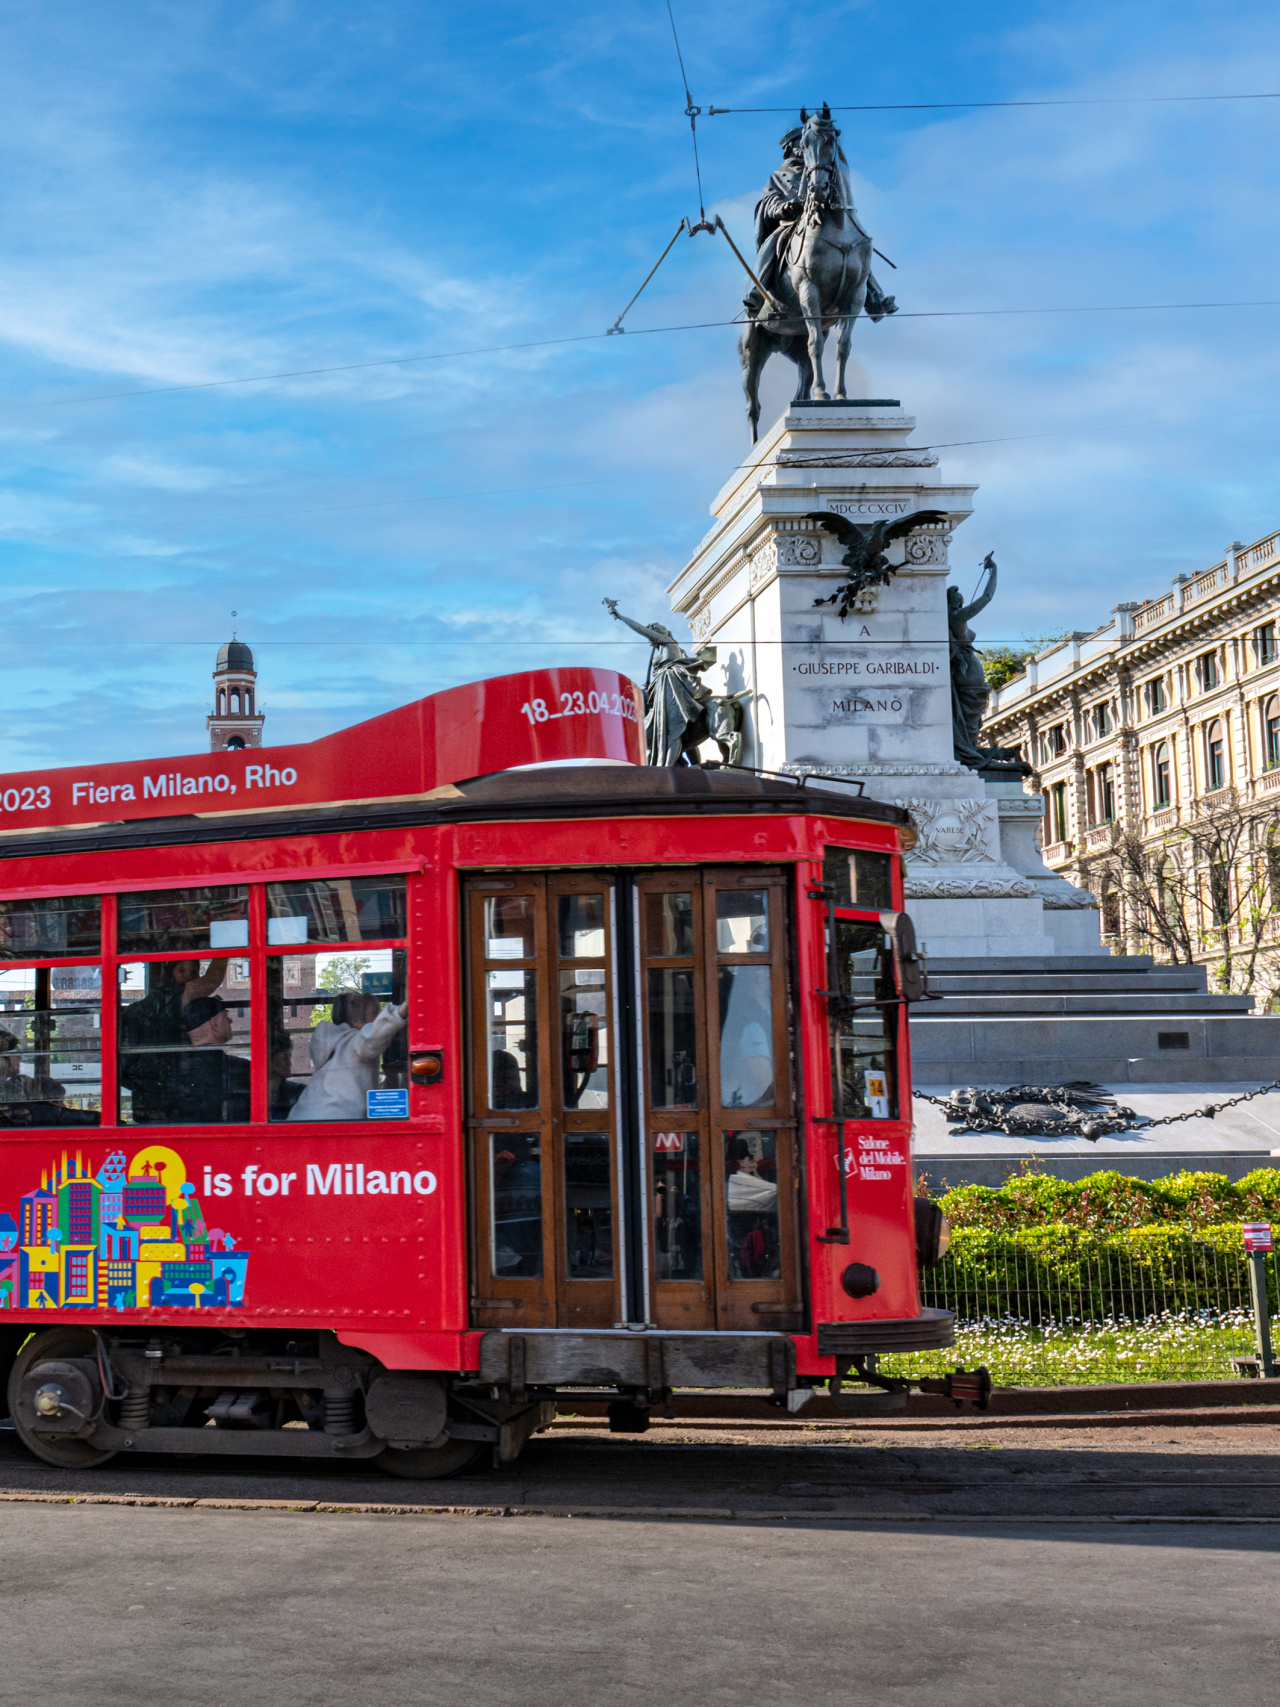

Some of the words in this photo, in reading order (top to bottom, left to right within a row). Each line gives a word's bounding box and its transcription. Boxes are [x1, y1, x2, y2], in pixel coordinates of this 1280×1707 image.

[829, 504, 907, 514] MDCCCXCIV
[859, 625, 871, 636] A
[832, 700, 903, 712] MILANO
[72, 782, 135, 806] Fiera
[143, 773, 238, 800] Milano,
[245, 764, 298, 789] Rho
[870, 1081, 884, 1096] 14
[858, 1135, 889, 1149] Salone
[859, 1151, 874, 1164] del
[203, 1165, 233, 1197] is
[241, 1165, 297, 1196] for
[306, 1163, 438, 1195] Milano
[860, 1166, 892, 1180] Milano
